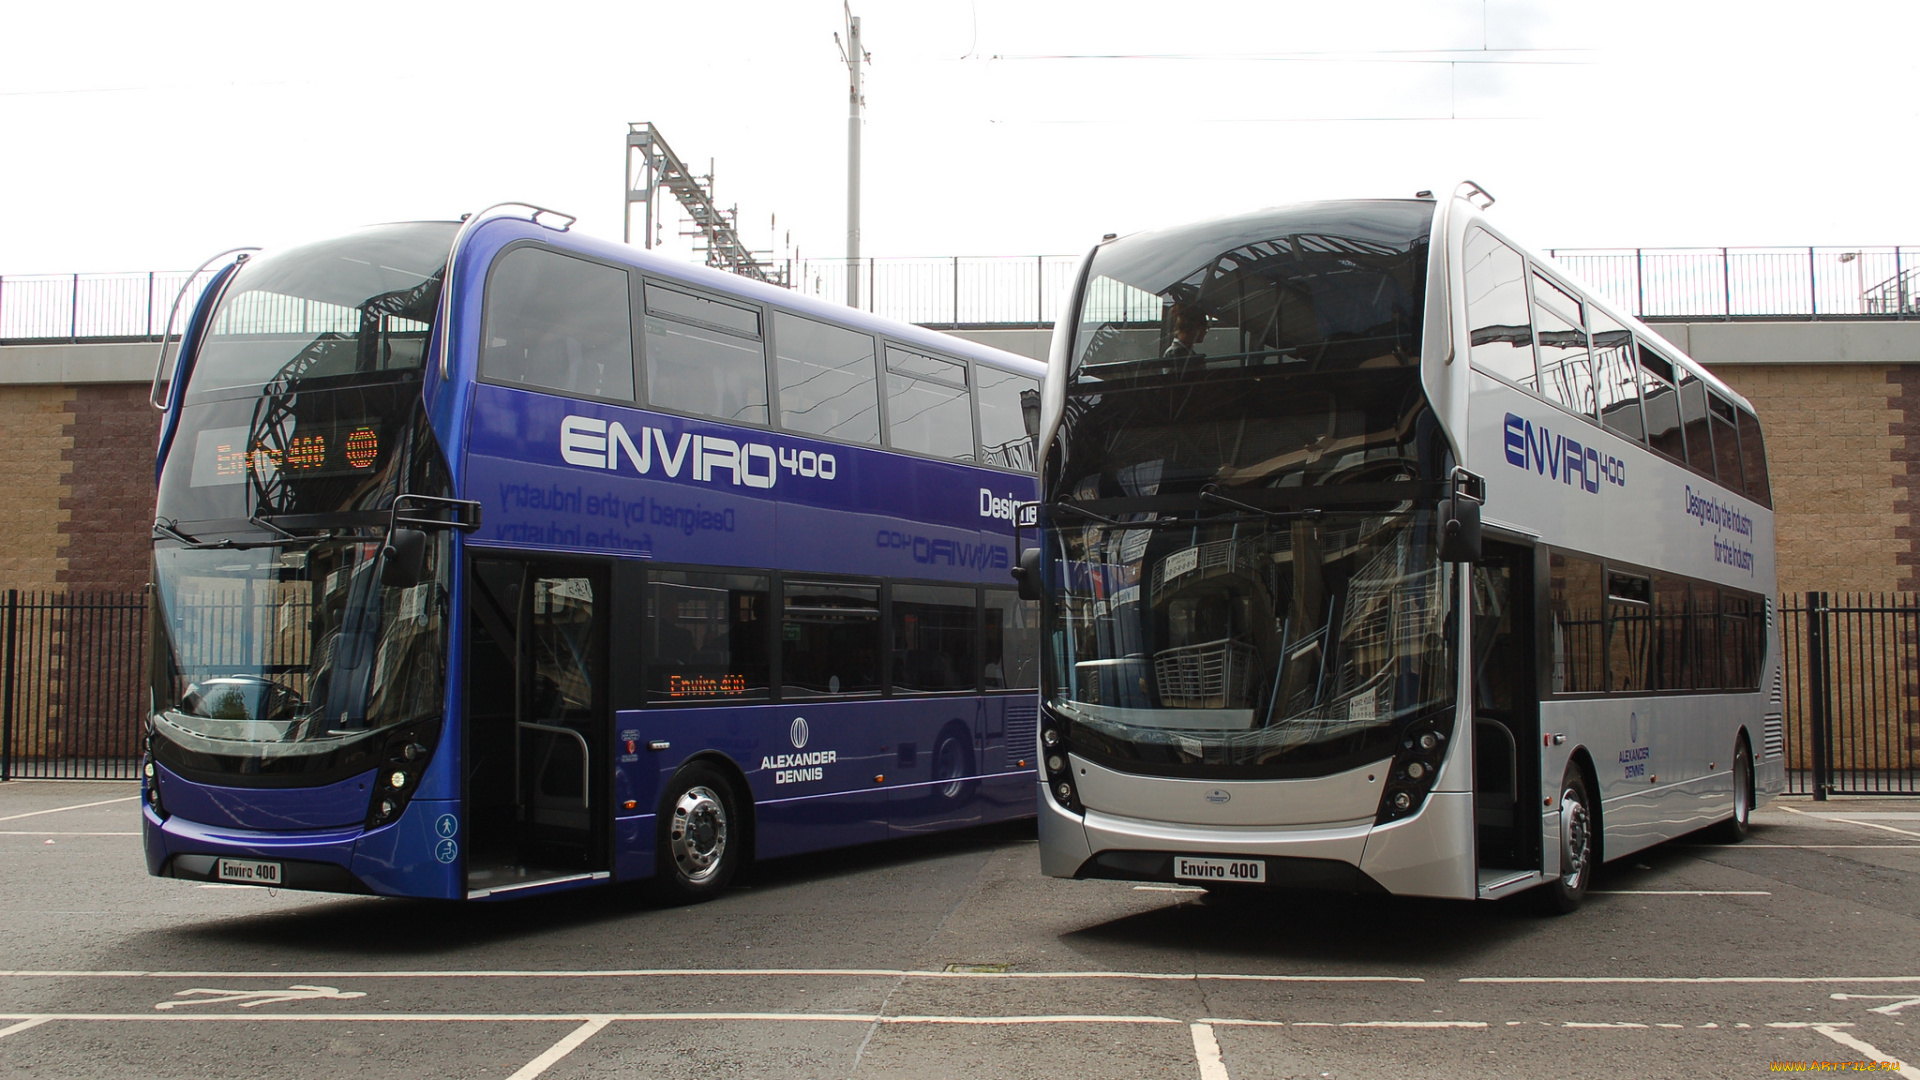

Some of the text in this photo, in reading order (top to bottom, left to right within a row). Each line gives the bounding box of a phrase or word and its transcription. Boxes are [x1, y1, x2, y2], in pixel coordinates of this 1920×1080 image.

[217, 435, 325, 475] Enviro 400
[1685, 485, 1714, 527] Designed
[670, 674, 744, 696] Enviro 400
[761, 750, 836, 769] ALEXANDER
[1619, 746, 1650, 763] ALEXANDER
[776, 767, 823, 784] DENNIS
[1625, 763, 1644, 778] DENNIS
[223, 861, 276, 880] Enviro 400
[1180, 860, 1258, 879] Enviro 400
